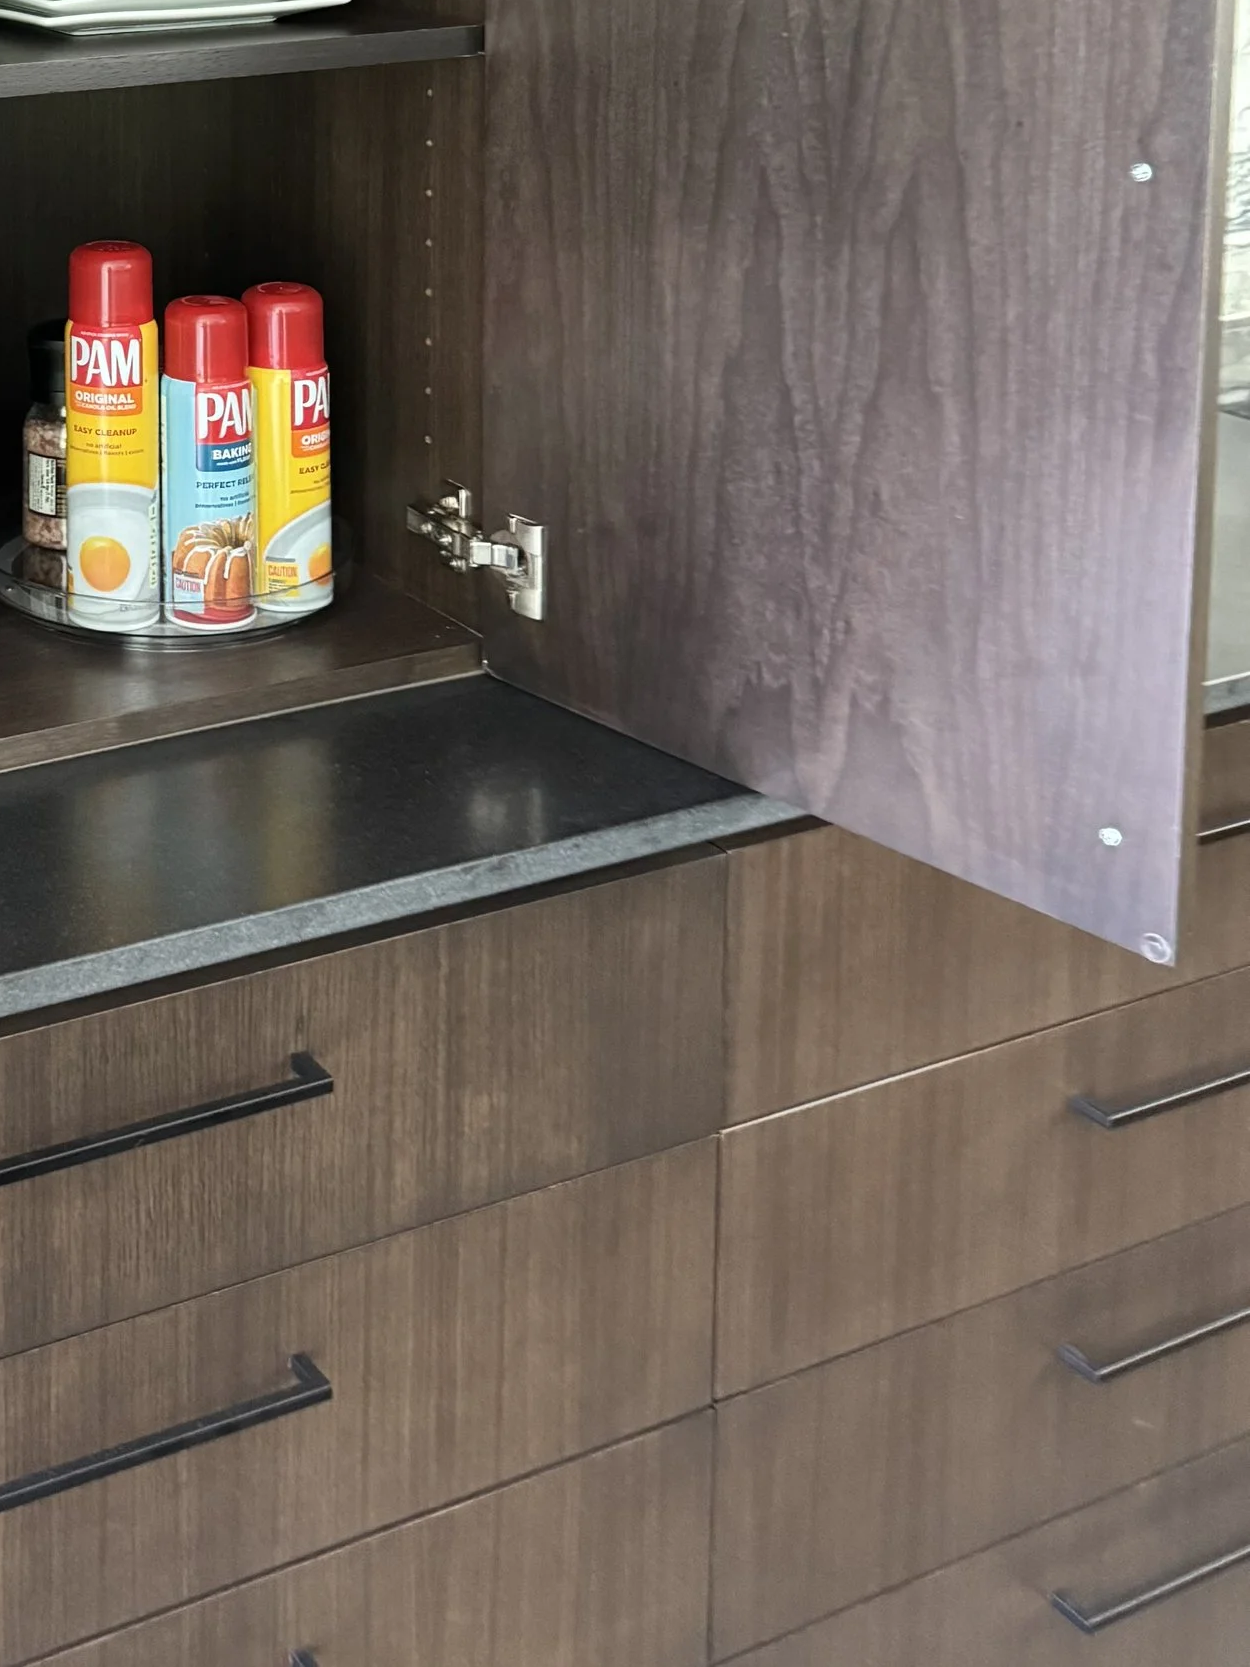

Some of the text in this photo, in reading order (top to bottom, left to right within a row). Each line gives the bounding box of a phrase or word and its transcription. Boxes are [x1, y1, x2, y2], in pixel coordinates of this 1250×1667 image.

[71, 335, 141, 387] PAM
[75, 390, 135, 405] ORIGINAL
[73, 424, 137, 437] EASY CLEANUP
[299, 464, 319, 475] EASY
[196, 480, 236, 489] PERFECT
